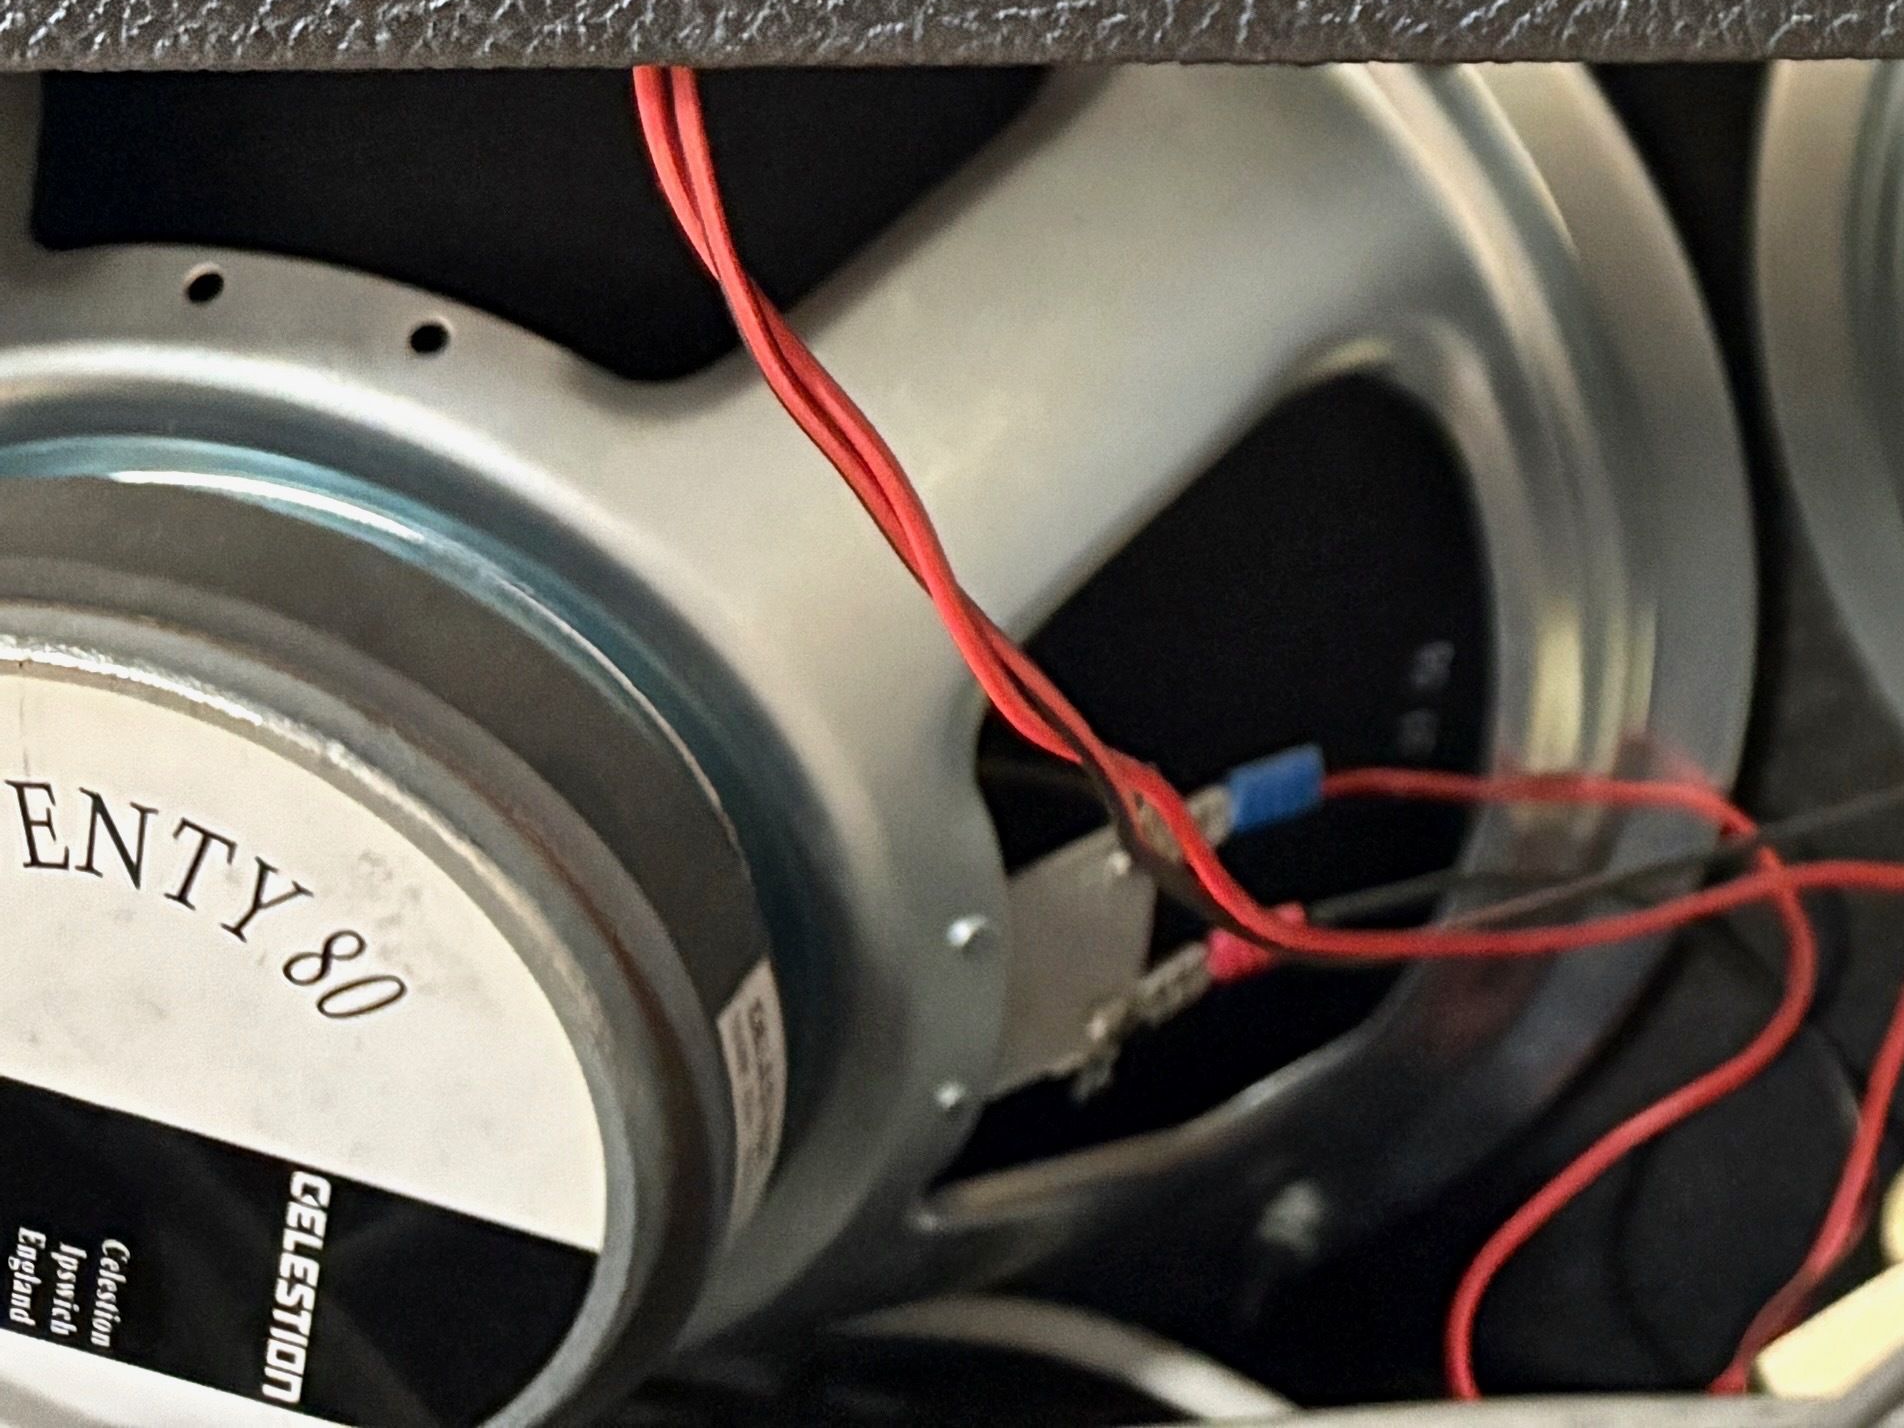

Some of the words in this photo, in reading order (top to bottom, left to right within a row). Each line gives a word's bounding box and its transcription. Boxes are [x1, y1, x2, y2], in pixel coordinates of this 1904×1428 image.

[4, 779, 314, 942] ENTY
[283, 930, 408, 1019] 80
[8, 1226, 46, 1326] England
[50, 1241, 87, 1335] Ipswich
[91, 1238, 130, 1347] Celestion
[262, 1171, 331, 1403] CELESTION
